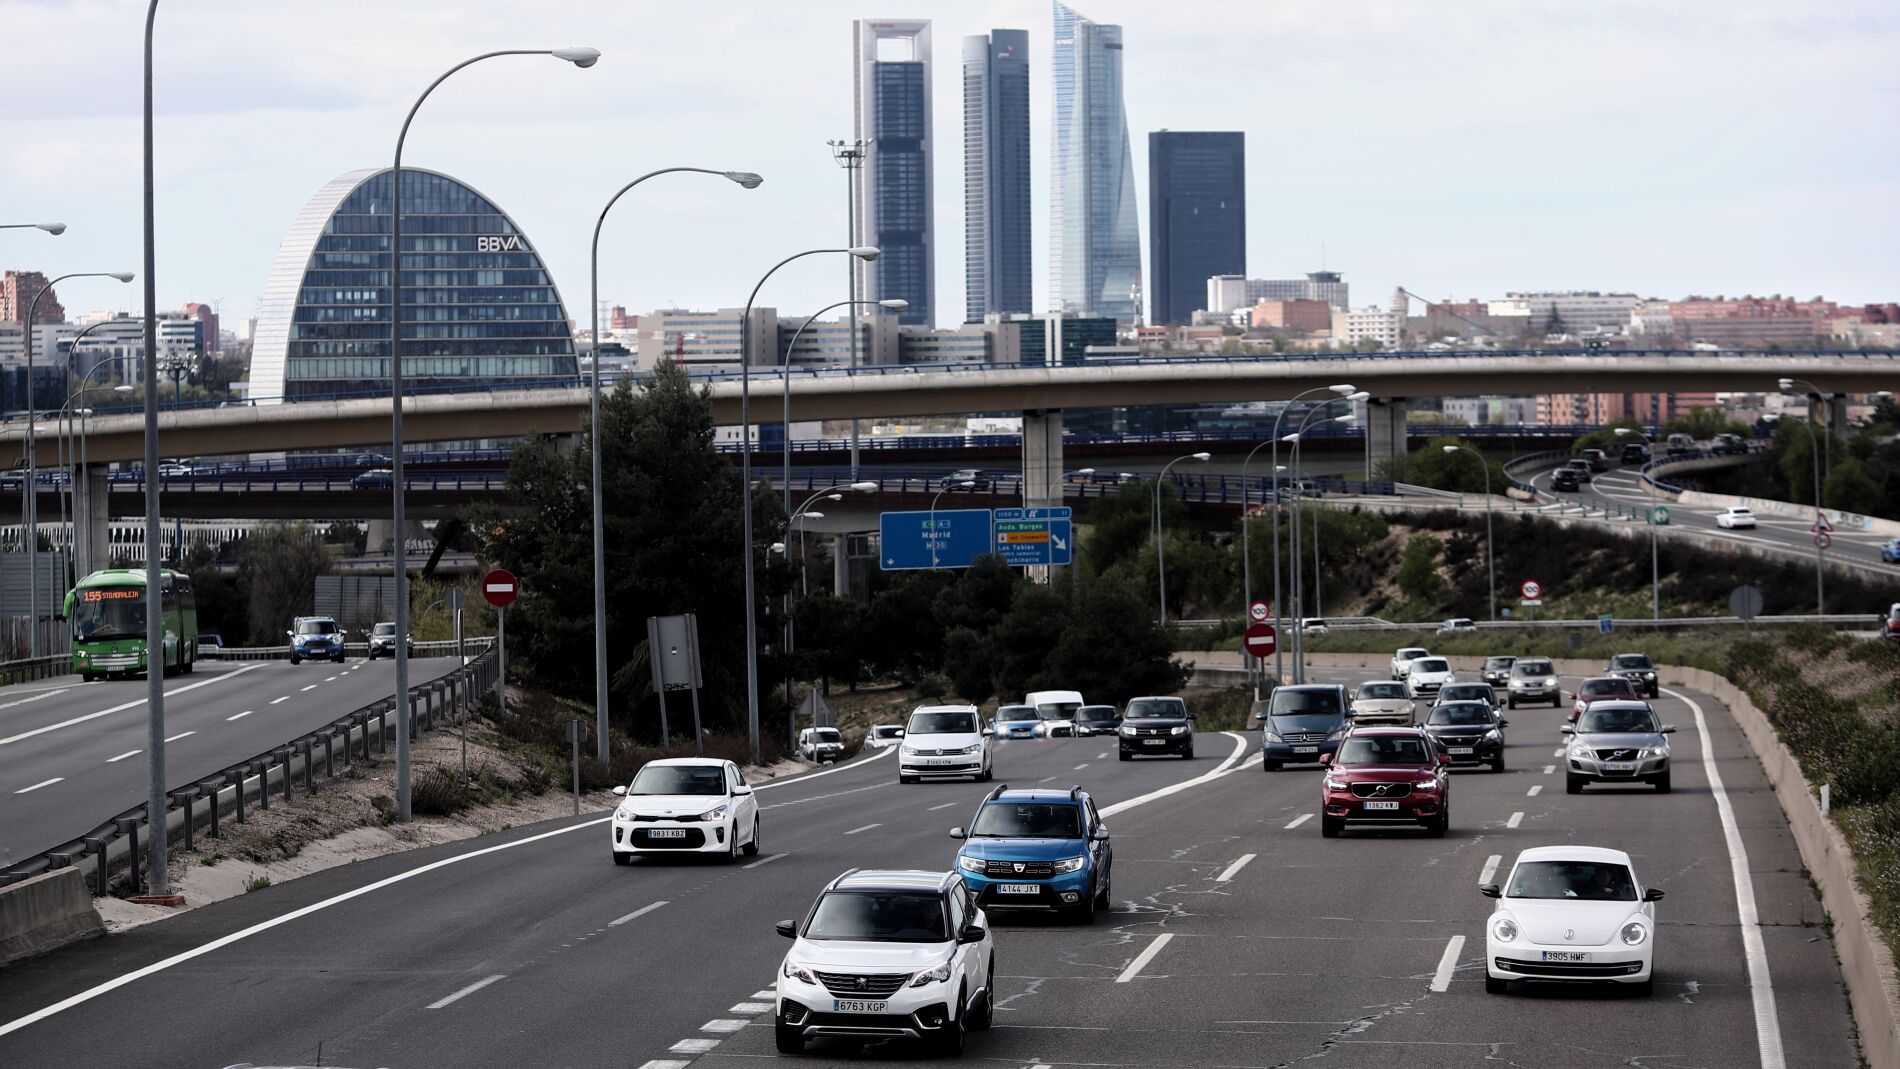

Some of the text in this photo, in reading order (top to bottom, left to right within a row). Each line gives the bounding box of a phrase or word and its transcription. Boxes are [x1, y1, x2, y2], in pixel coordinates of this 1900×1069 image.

[478, 235, 522, 251] BBVA
[84, 591, 102, 601] 155
[1252, 607, 1267, 615] 100
[1547, 952, 1569, 960] 3905
[840, 1001, 885, 1012] 6763 KGP
